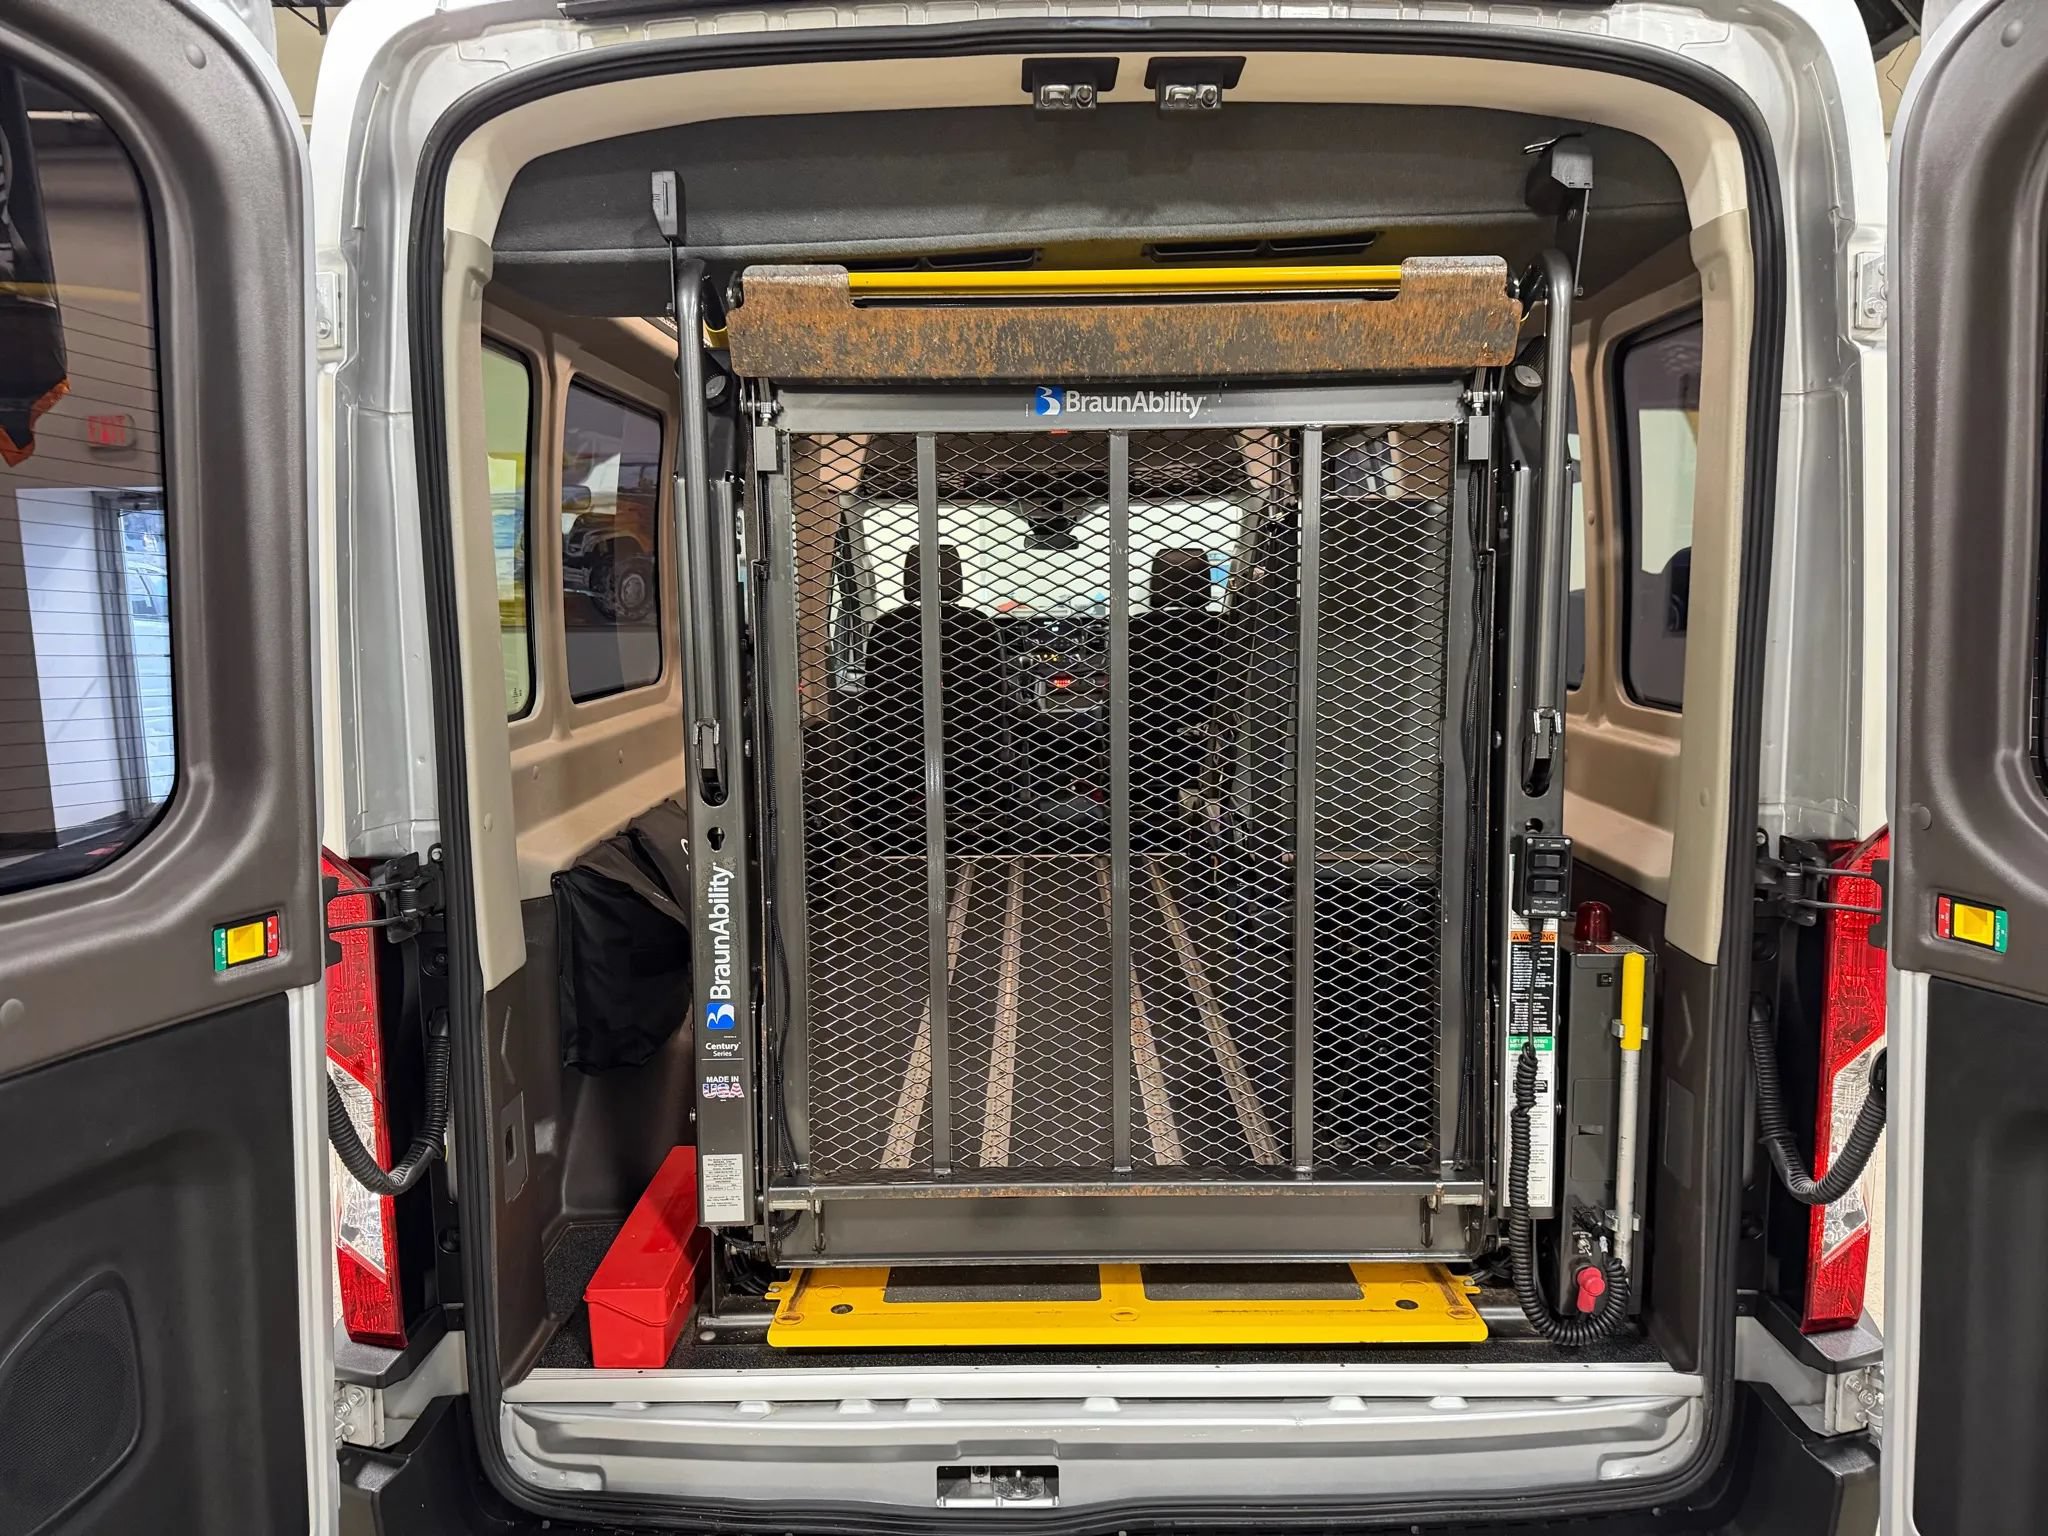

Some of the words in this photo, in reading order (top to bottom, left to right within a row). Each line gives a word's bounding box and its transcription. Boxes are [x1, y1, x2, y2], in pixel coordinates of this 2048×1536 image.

[1065, 390, 1204, 419] BraunAbility
[707, 865, 735, 1000] BraunAbility
[705, 1042, 739, 1051] Century
[706, 1075, 730, 1083] MADE
[730, 1075, 740, 1083] IN
[702, 1082, 745, 1099] USA
